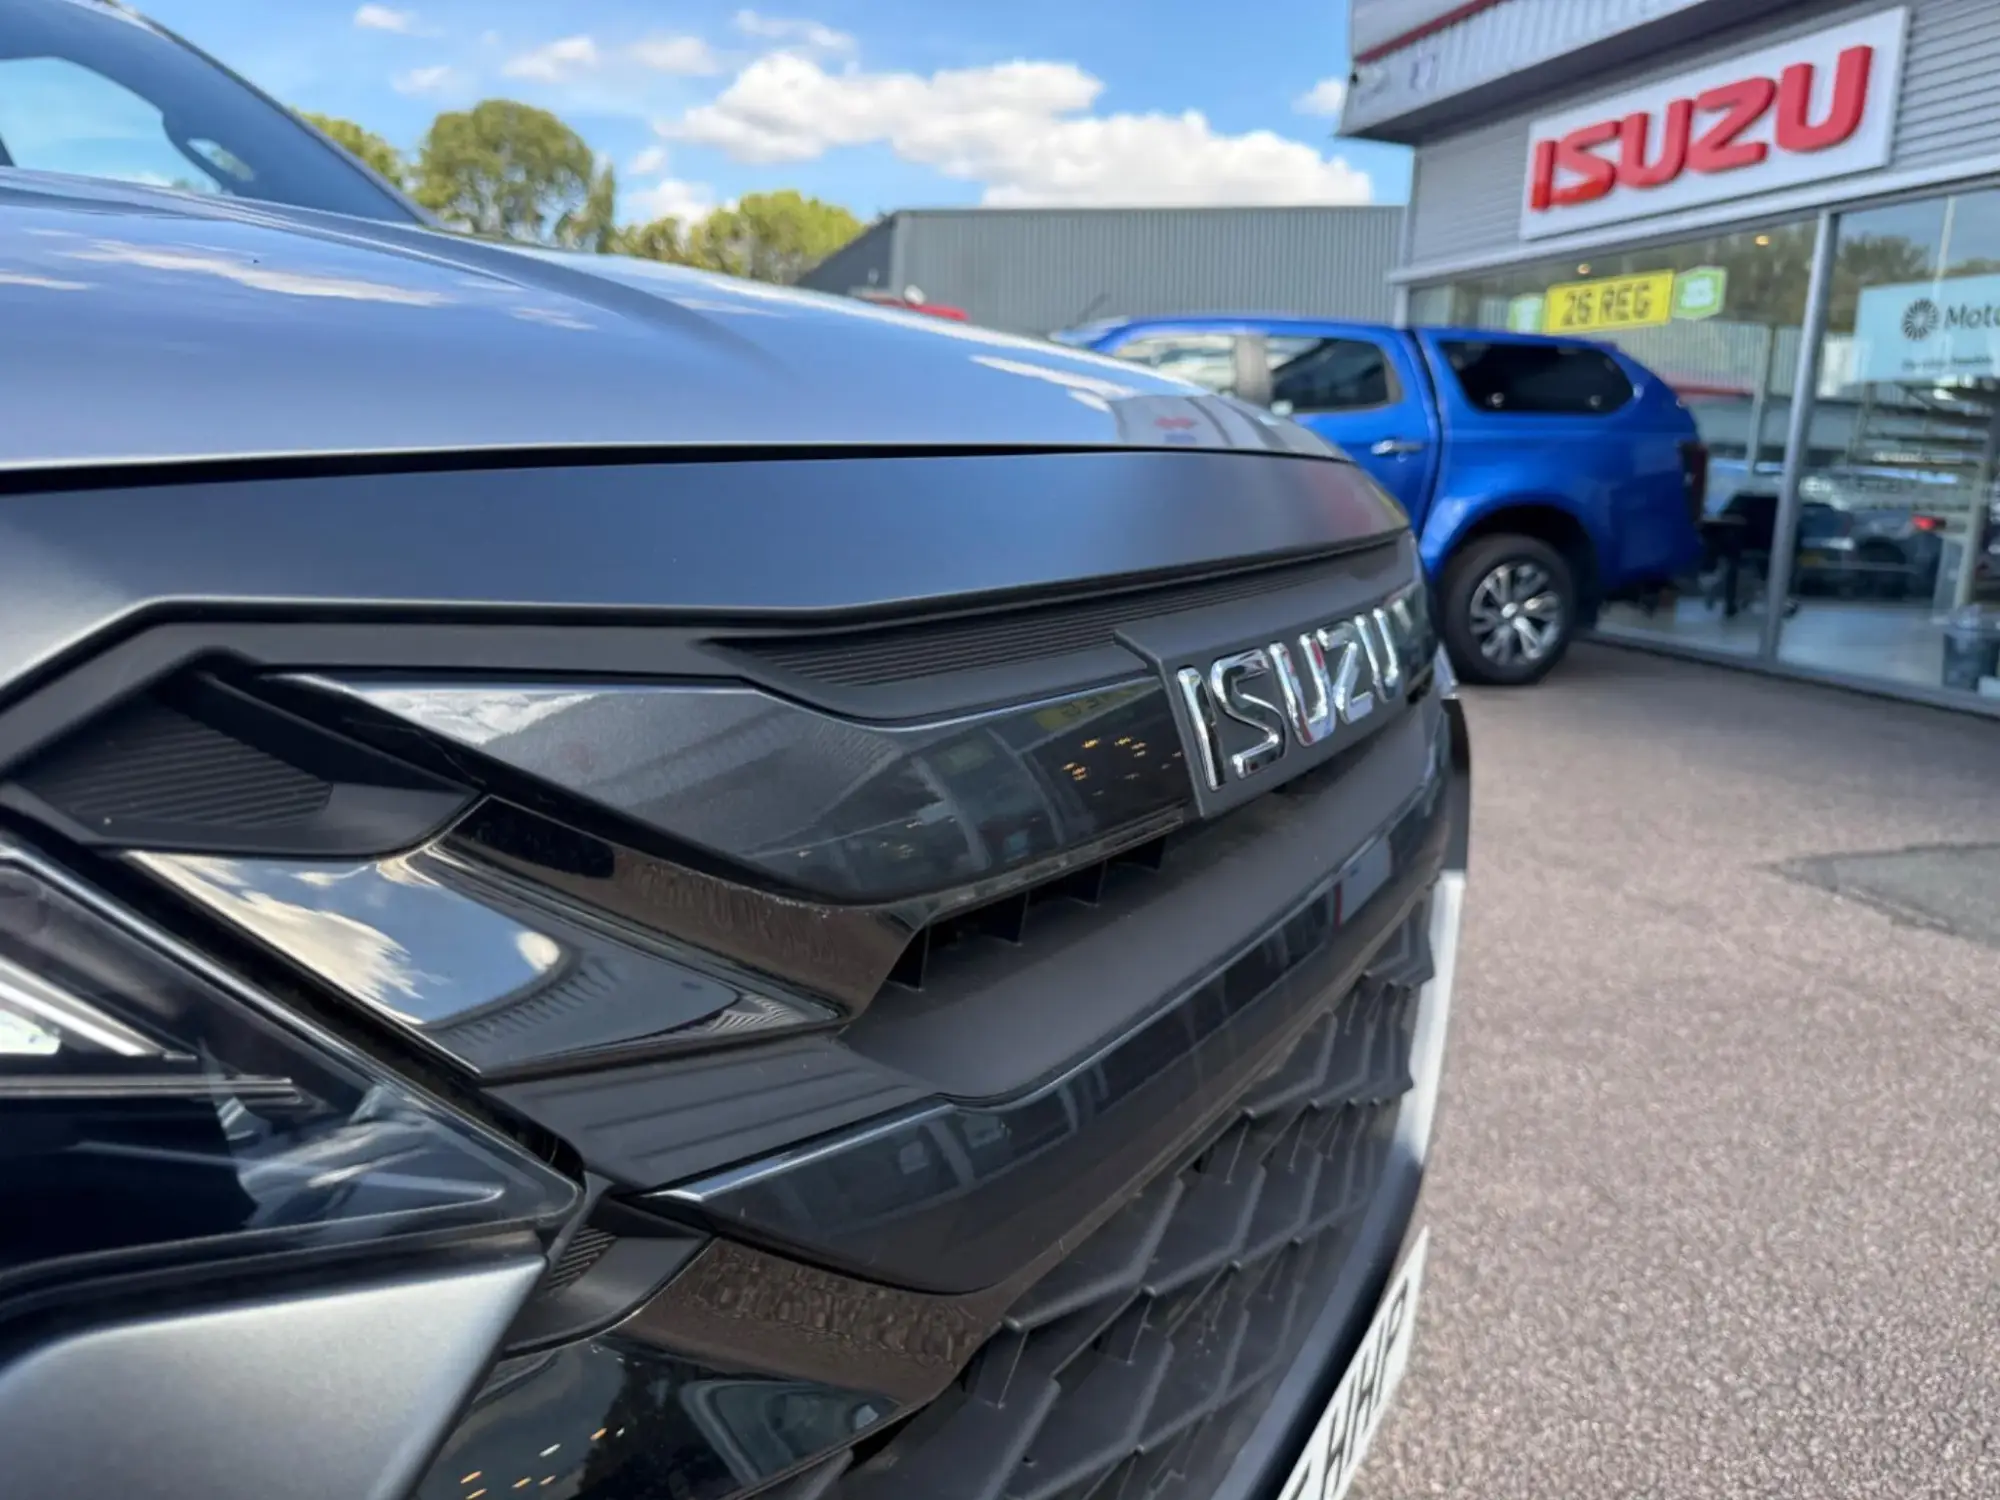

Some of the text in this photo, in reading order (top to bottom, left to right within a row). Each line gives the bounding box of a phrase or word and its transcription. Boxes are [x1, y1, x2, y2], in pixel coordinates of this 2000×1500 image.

[1529, 44, 1874, 212] ISUZU
[1600, 282, 1651, 321] REG
[1176, 607, 1400, 792] ISUZU
